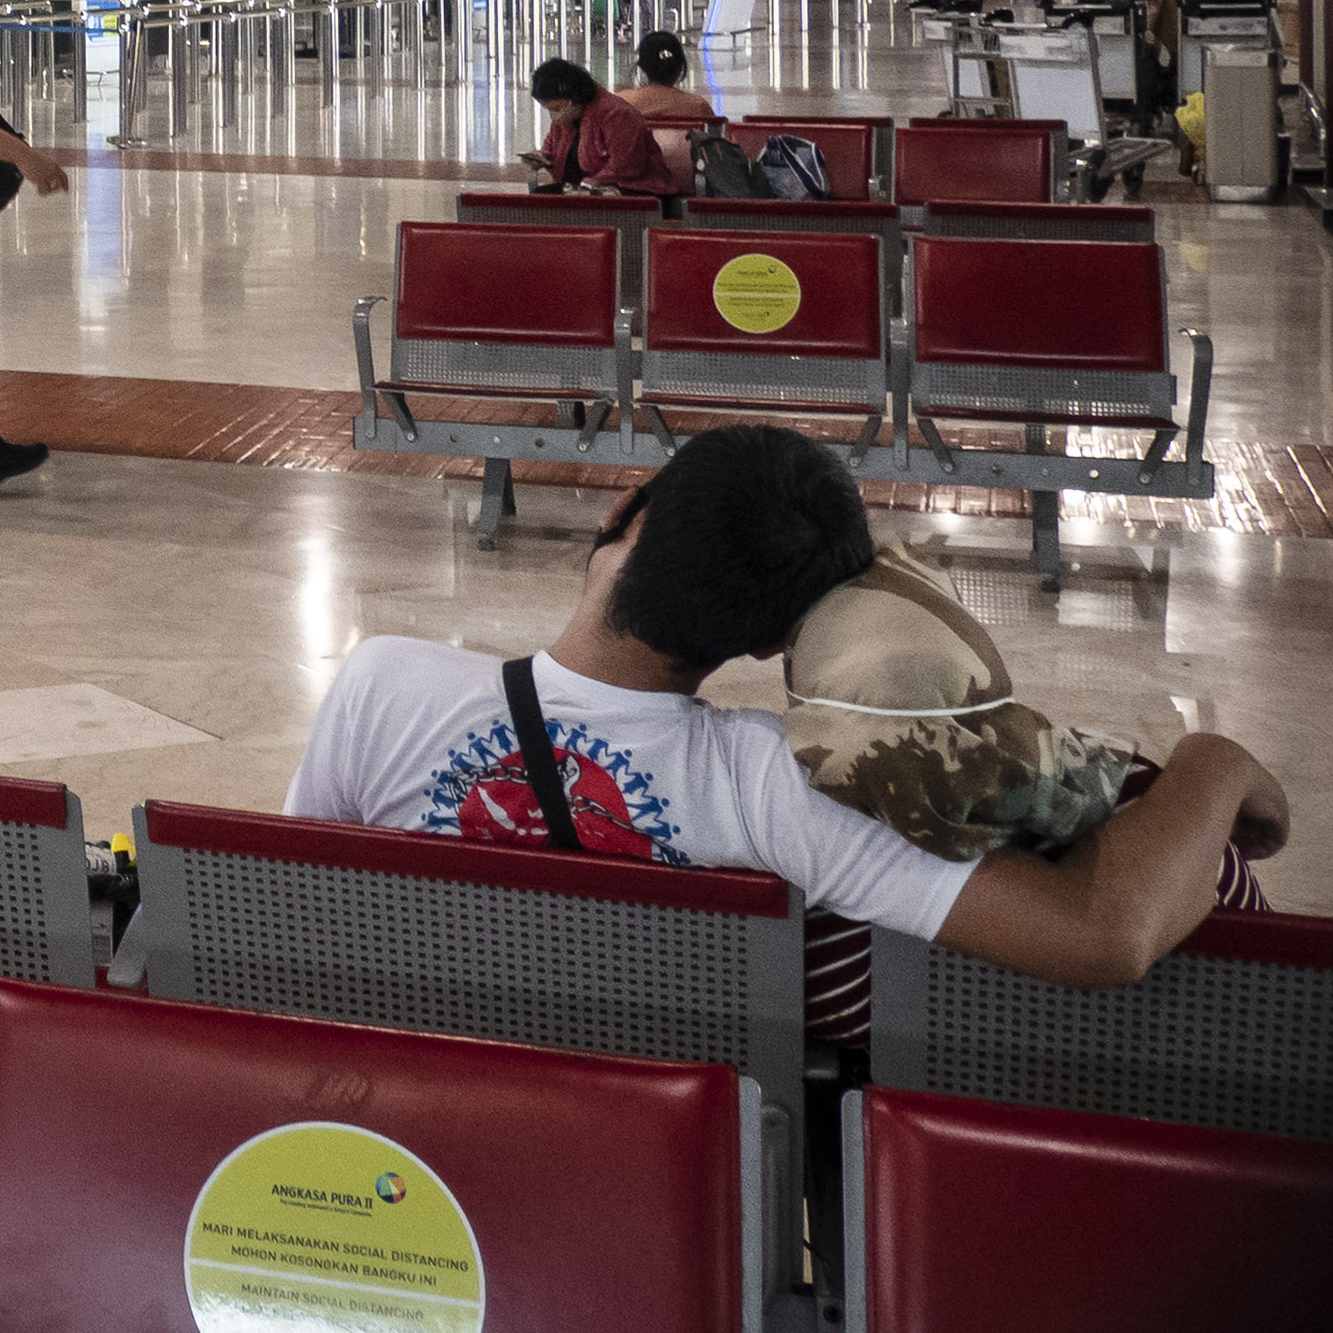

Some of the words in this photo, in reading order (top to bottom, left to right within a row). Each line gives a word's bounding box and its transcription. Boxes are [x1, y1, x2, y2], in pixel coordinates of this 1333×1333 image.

[272, 1184, 327, 1203] ANGKASA
[331, 1192, 363, 1209] PURA
[202, 1222, 233, 1236] MARI
[236, 1227, 340, 1253] MELAKSANAKAN
[342, 1243, 388, 1261] SOCIAL
[391, 1250, 469, 1273] DISTANCING
[231, 1245, 277, 1263] MOHON
[280, 1253, 358, 1275] KOSONGKAN
[362, 1265, 416, 1284] BANGKU
[419, 1275, 437, 1286] INI
[241, 1284, 300, 1302] MAINTAIN
